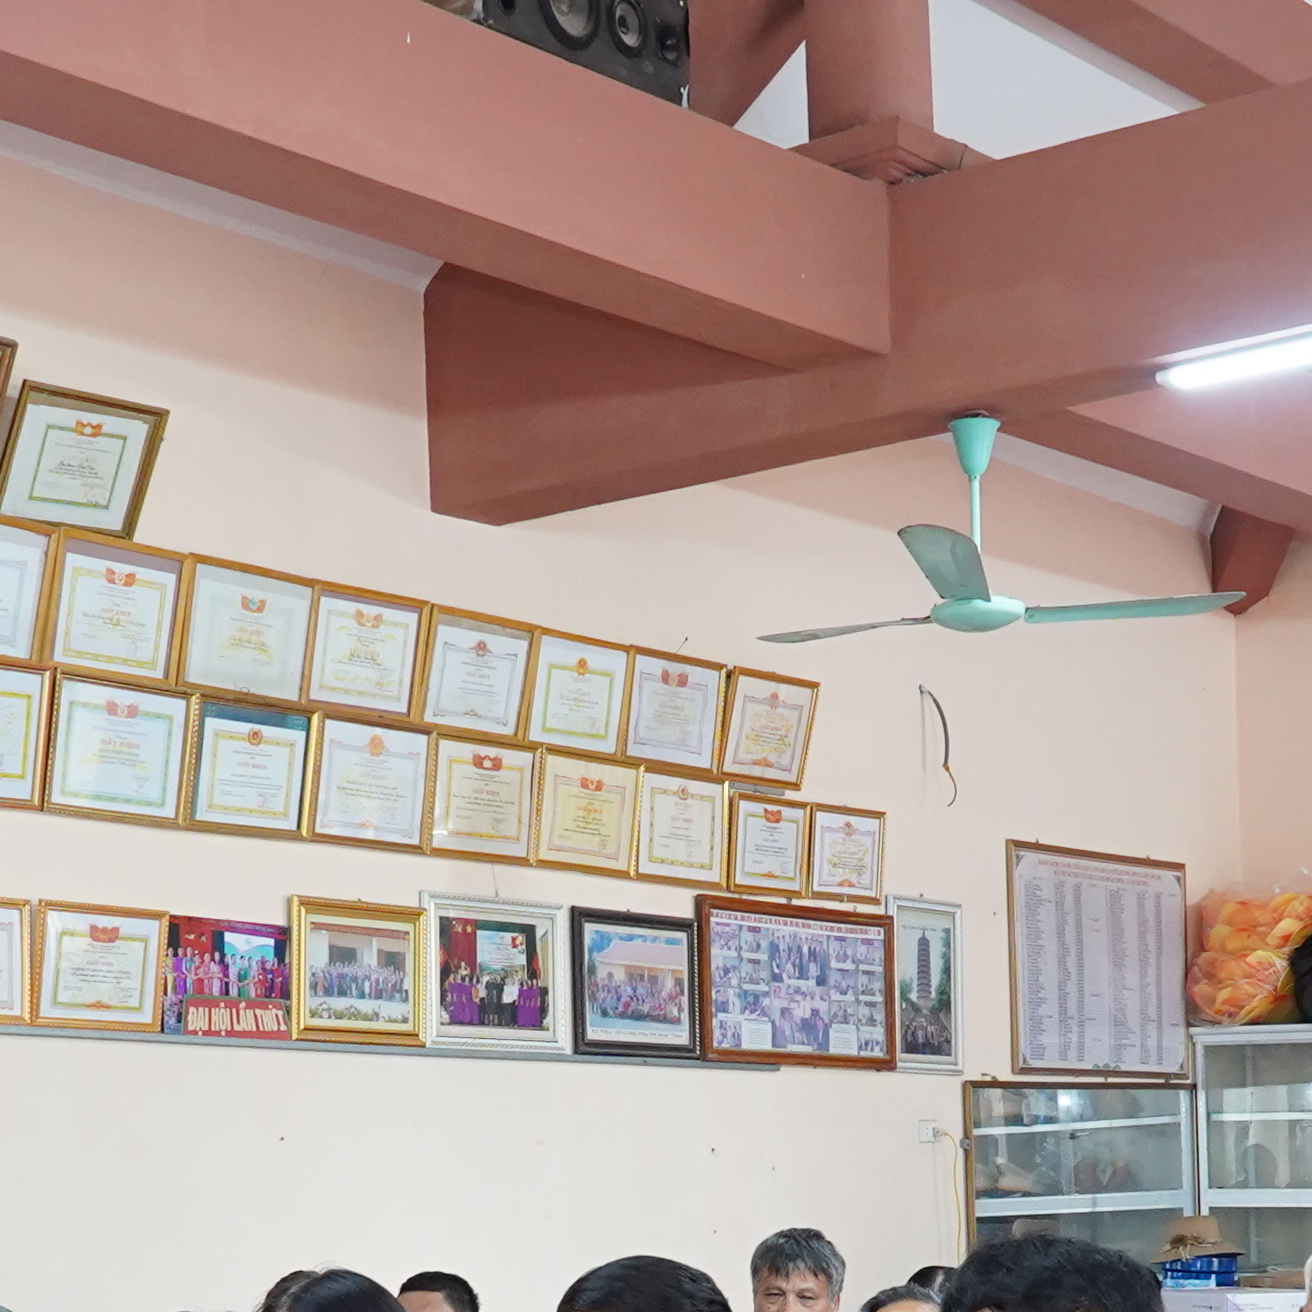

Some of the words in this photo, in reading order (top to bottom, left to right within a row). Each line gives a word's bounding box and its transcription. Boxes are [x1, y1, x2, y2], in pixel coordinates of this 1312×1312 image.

[188, 1007, 209, 1036] ĐẠI
[211, 1002, 232, 1036] HỘI
[233, 1001, 256, 1031] LẦN
[255, 1004, 278, 1031] THỨ
